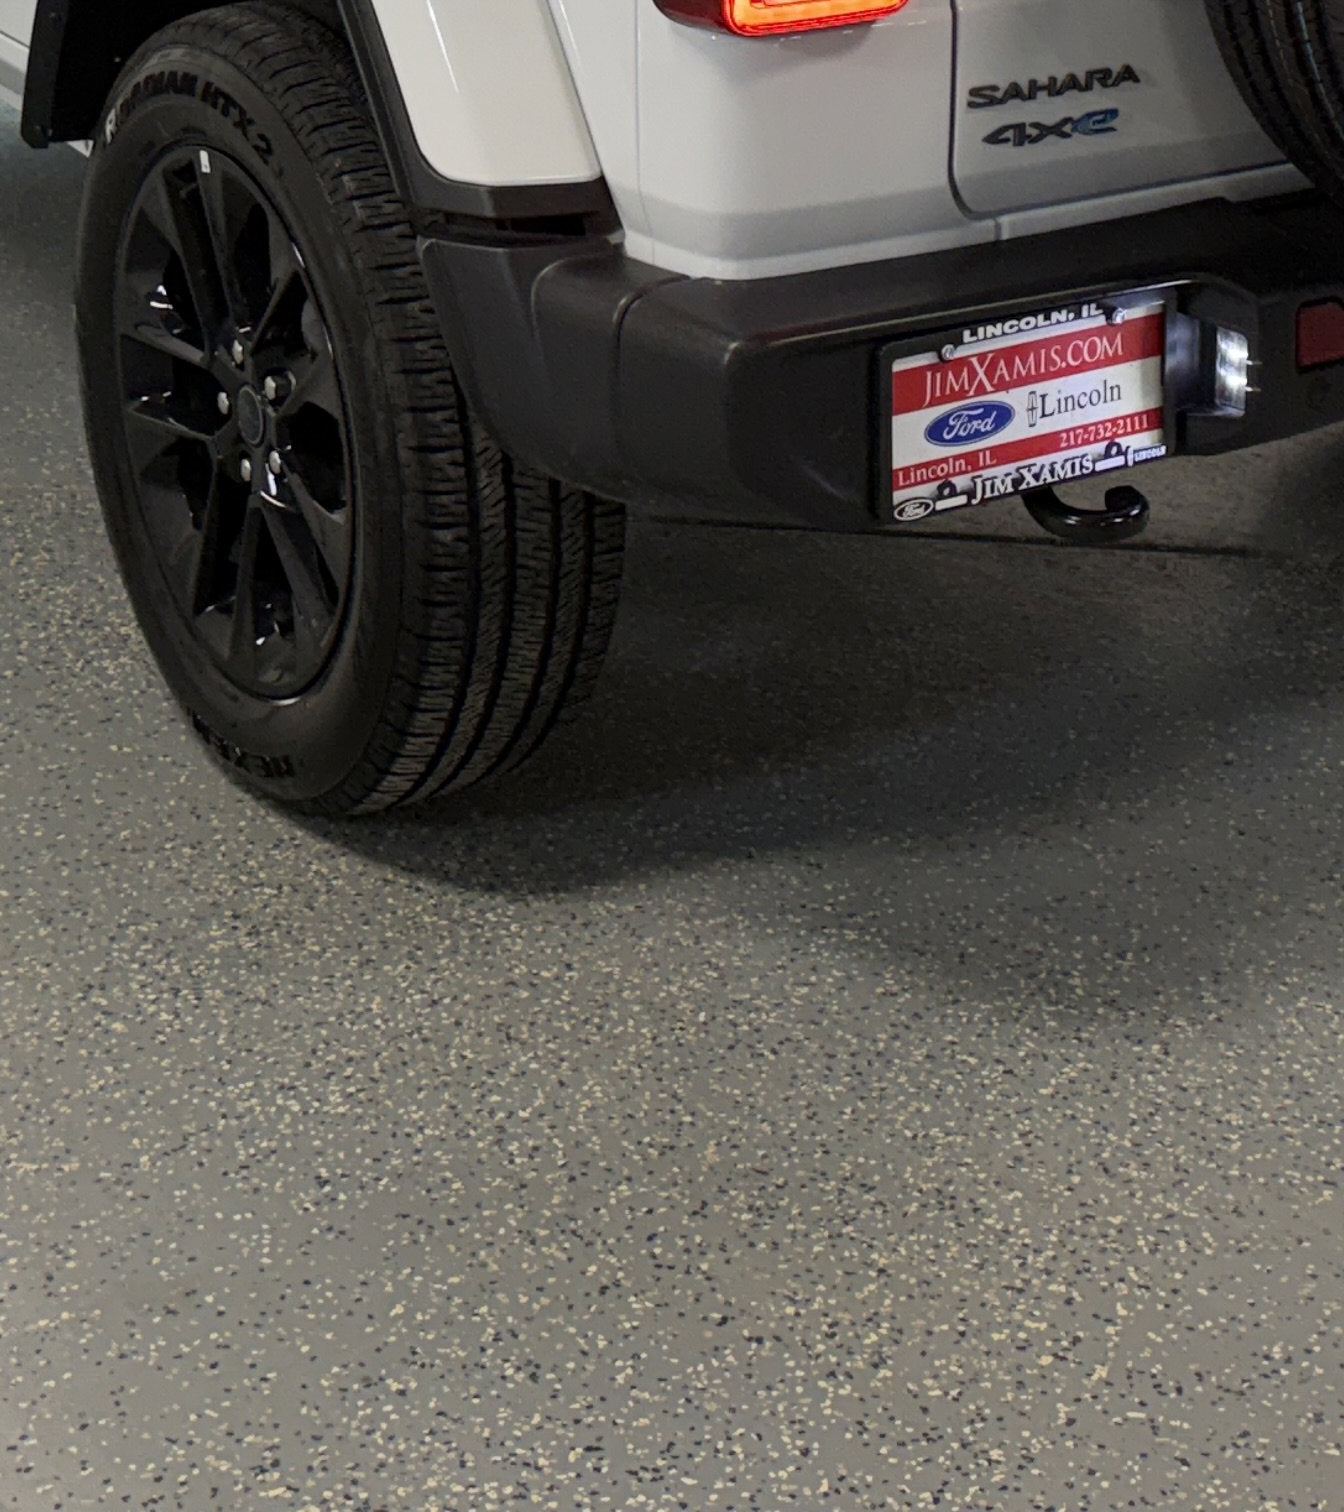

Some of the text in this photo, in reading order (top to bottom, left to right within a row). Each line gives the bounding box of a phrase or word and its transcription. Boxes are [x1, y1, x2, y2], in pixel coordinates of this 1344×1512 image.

[967, 64, 1140, 109] SAHARA
[963, 302, 1103, 344] LINCOLN, IL
[1038, 380, 1121, 418] Lincoln
[943, 408, 995, 439] Ford
[1060, 415, 1149, 447] 217-732-2111
[979, 452, 996, 466] IL
